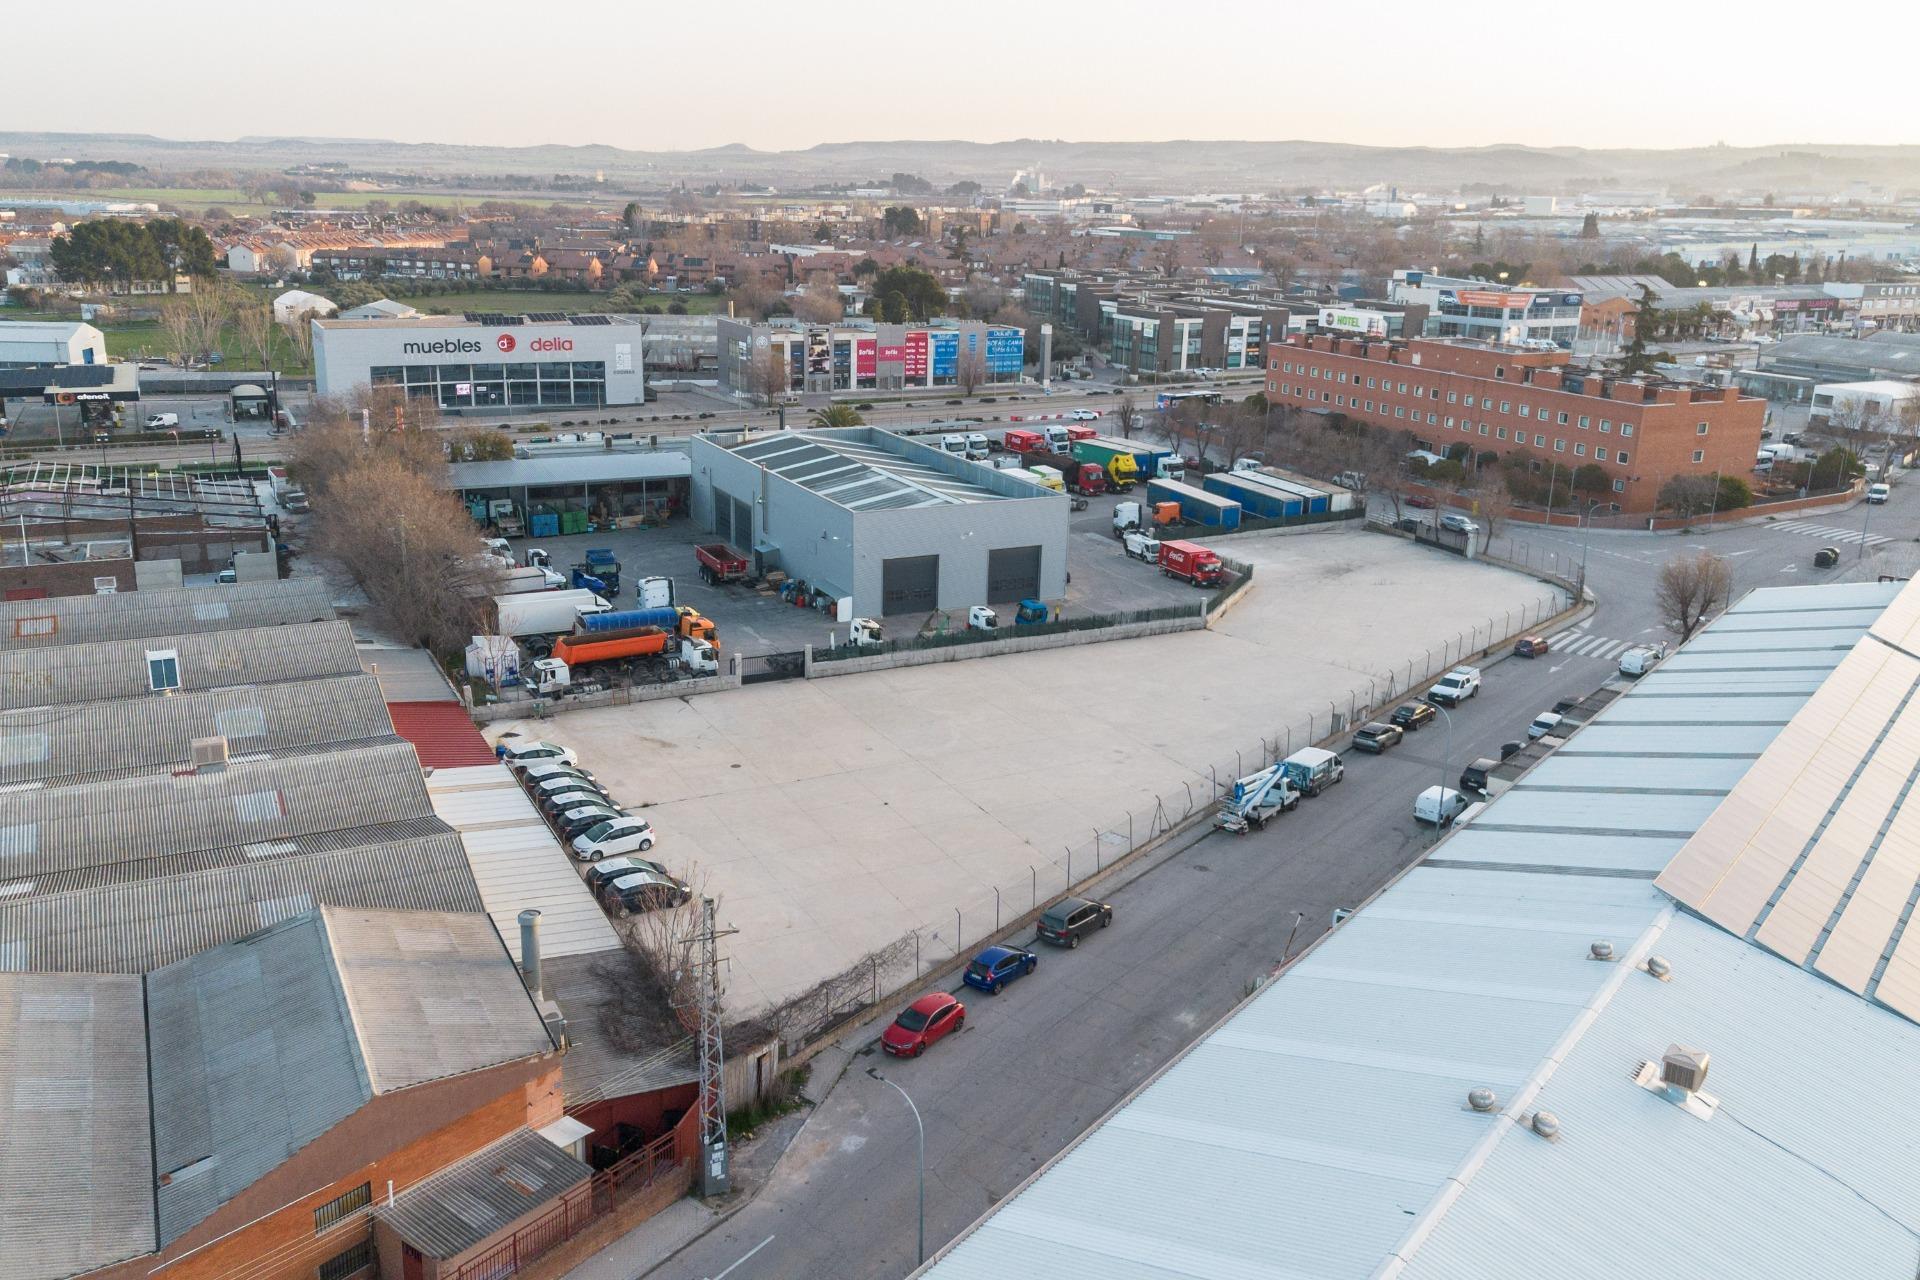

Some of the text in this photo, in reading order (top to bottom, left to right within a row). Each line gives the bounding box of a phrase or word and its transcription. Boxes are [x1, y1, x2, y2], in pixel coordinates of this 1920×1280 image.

[1337, 315, 1361, 327] HOTEL
[404, 339, 482, 354] muebles
[530, 337, 573, 351] delia
